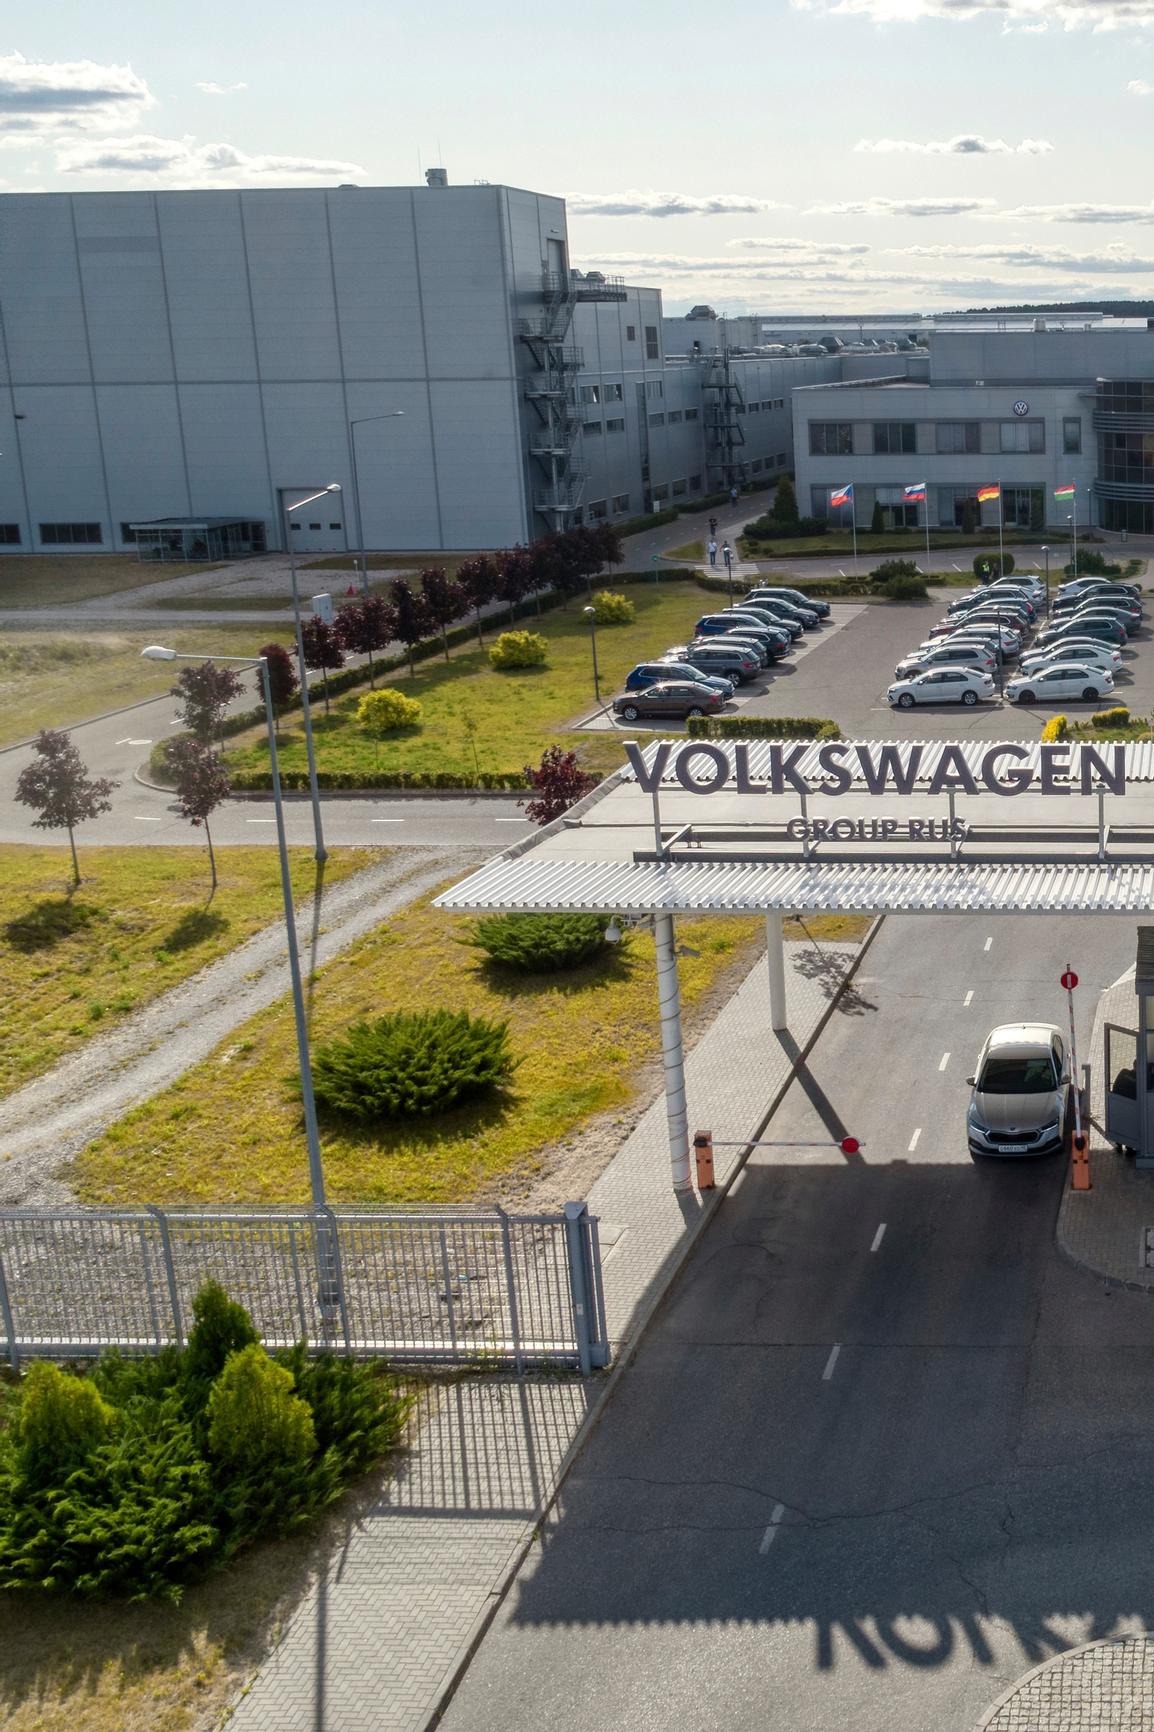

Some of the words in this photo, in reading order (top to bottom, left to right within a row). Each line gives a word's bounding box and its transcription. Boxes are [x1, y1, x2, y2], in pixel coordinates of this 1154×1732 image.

[622, 740, 1126, 796] VOLKSWAGEN
[787, 816, 898, 841] GROUP
[908, 816, 968, 842] RUS
